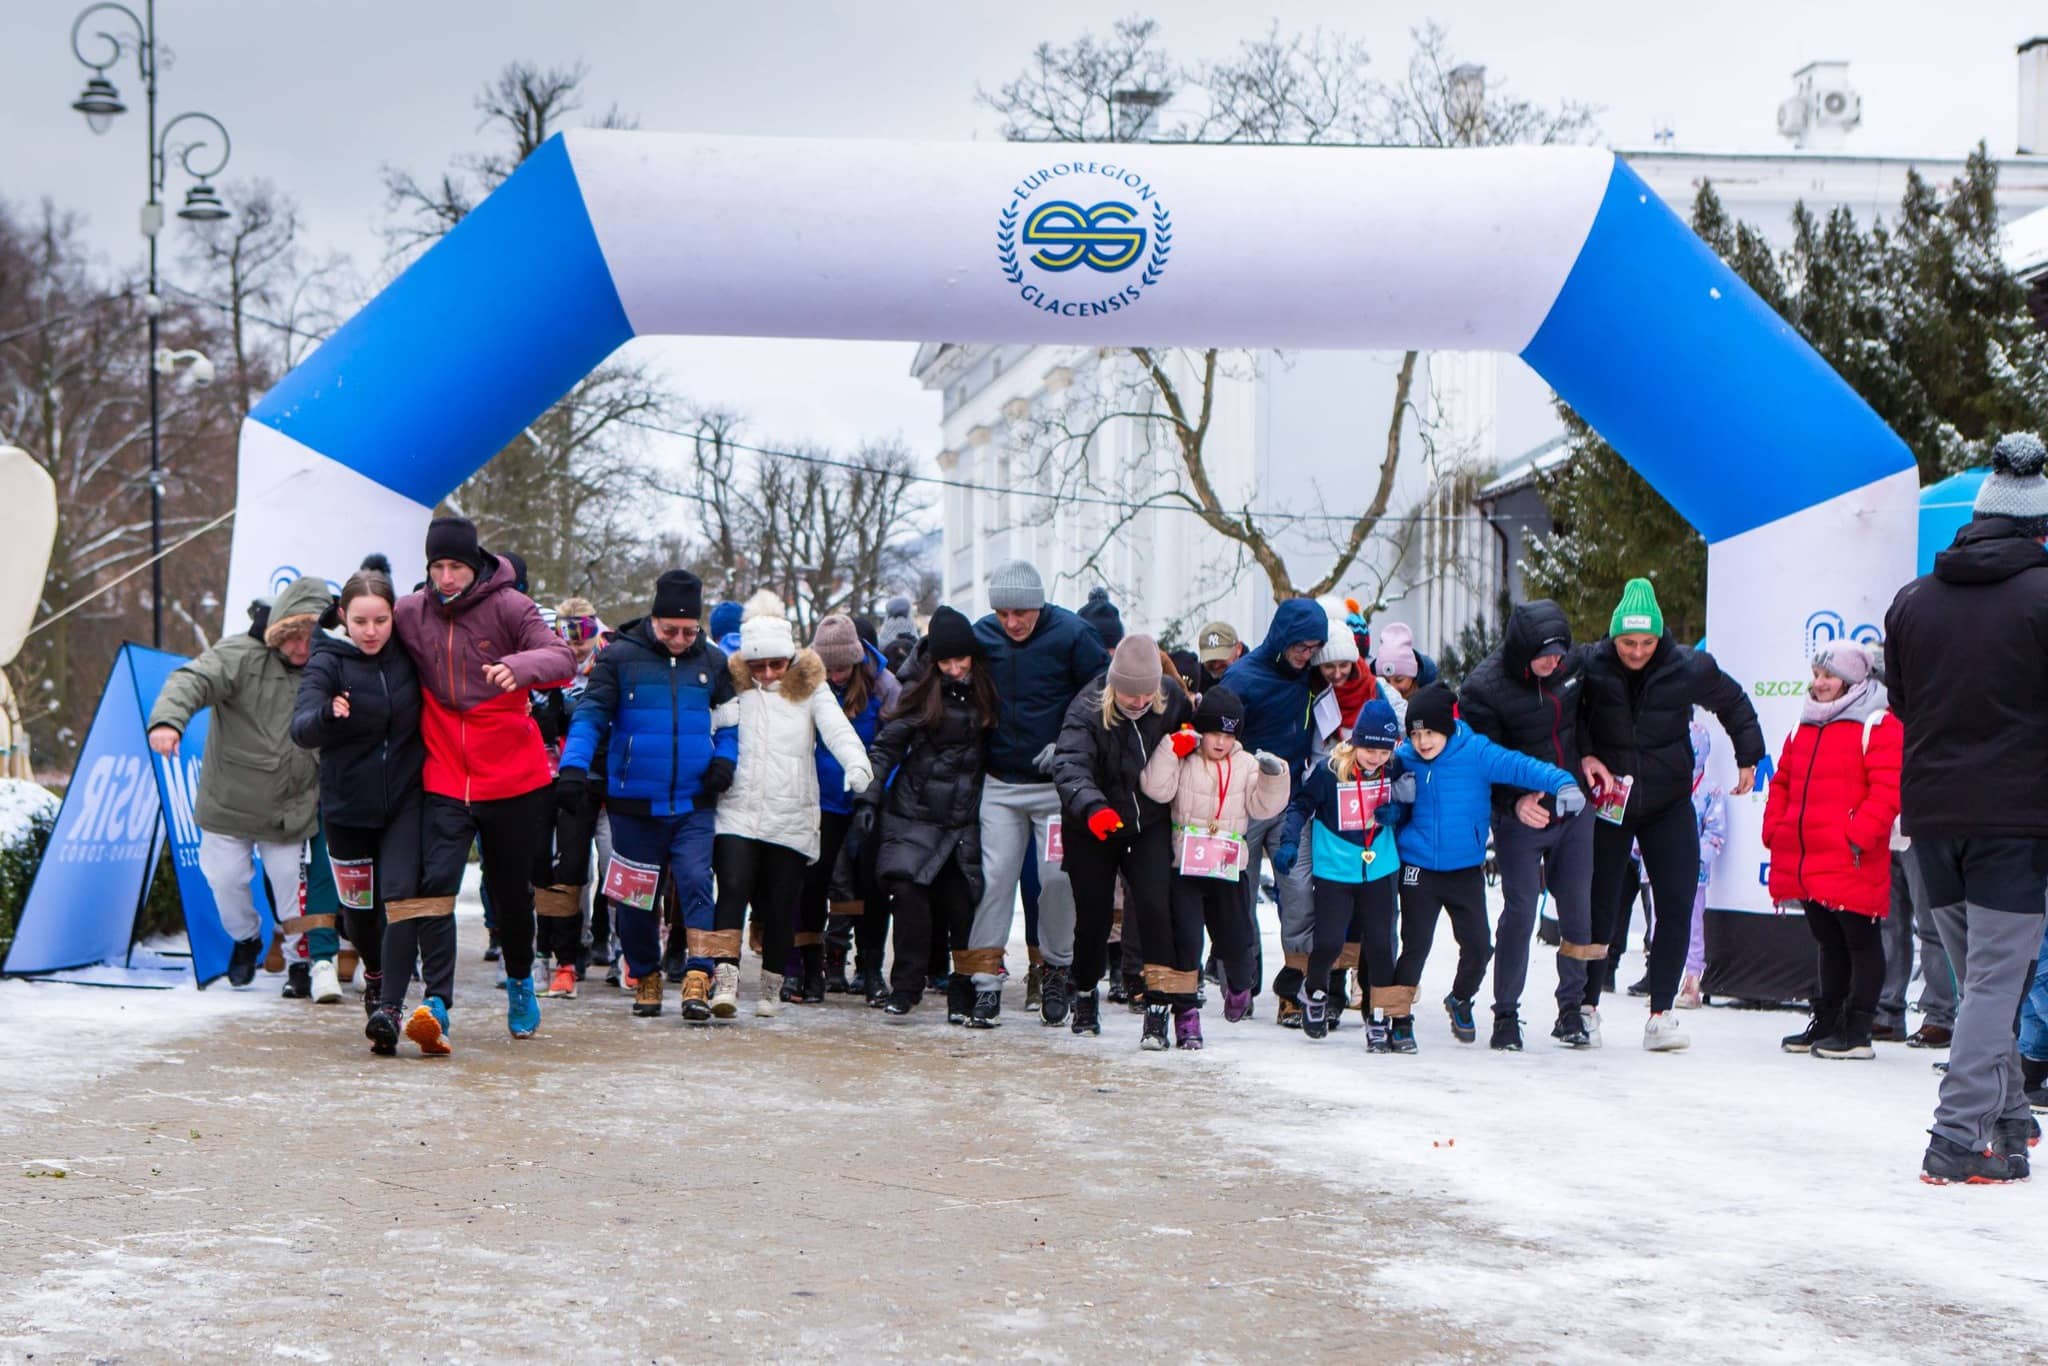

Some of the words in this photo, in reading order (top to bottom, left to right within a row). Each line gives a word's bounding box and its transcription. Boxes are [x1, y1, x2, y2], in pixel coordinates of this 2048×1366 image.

[1013, 161, 1156, 201] EUROREGION
[1020, 284, 1141, 317] GLACENSIS
[1349, 799, 1361, 814] 9
[1195, 846, 1205, 860] 3
[614, 872, 623, 886] 5
